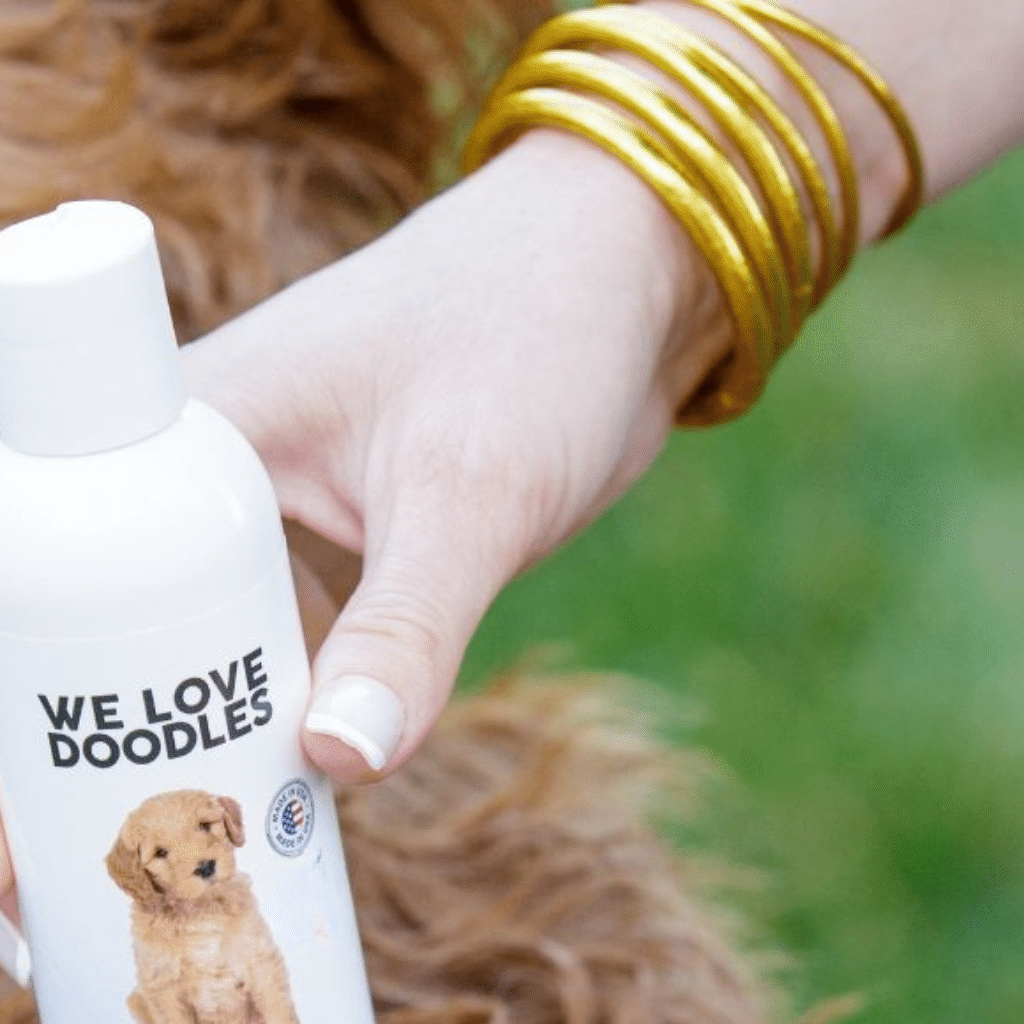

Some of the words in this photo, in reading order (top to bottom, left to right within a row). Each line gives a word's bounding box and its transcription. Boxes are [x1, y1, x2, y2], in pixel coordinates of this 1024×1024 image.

[37, 693, 124, 731] WE
[141, 646, 267, 724] LOVE
[47, 687, 273, 768] DOODLES
